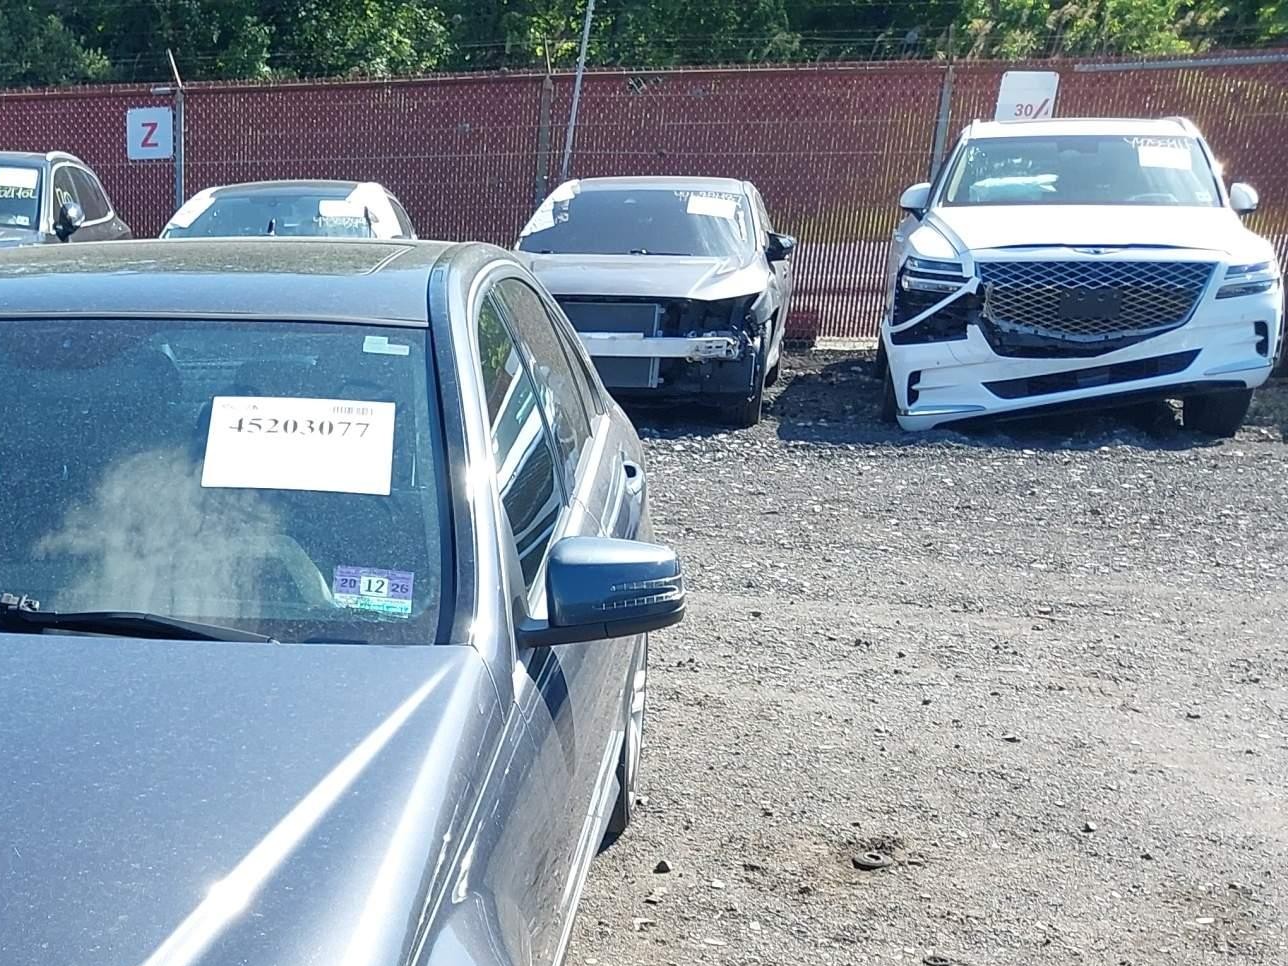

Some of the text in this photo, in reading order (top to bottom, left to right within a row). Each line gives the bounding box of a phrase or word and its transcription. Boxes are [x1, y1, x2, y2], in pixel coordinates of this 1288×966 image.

[141, 122, 158, 148] Z
[229, 417, 369, 437] 45203077
[340, 578, 409, 593] 20 12 26
